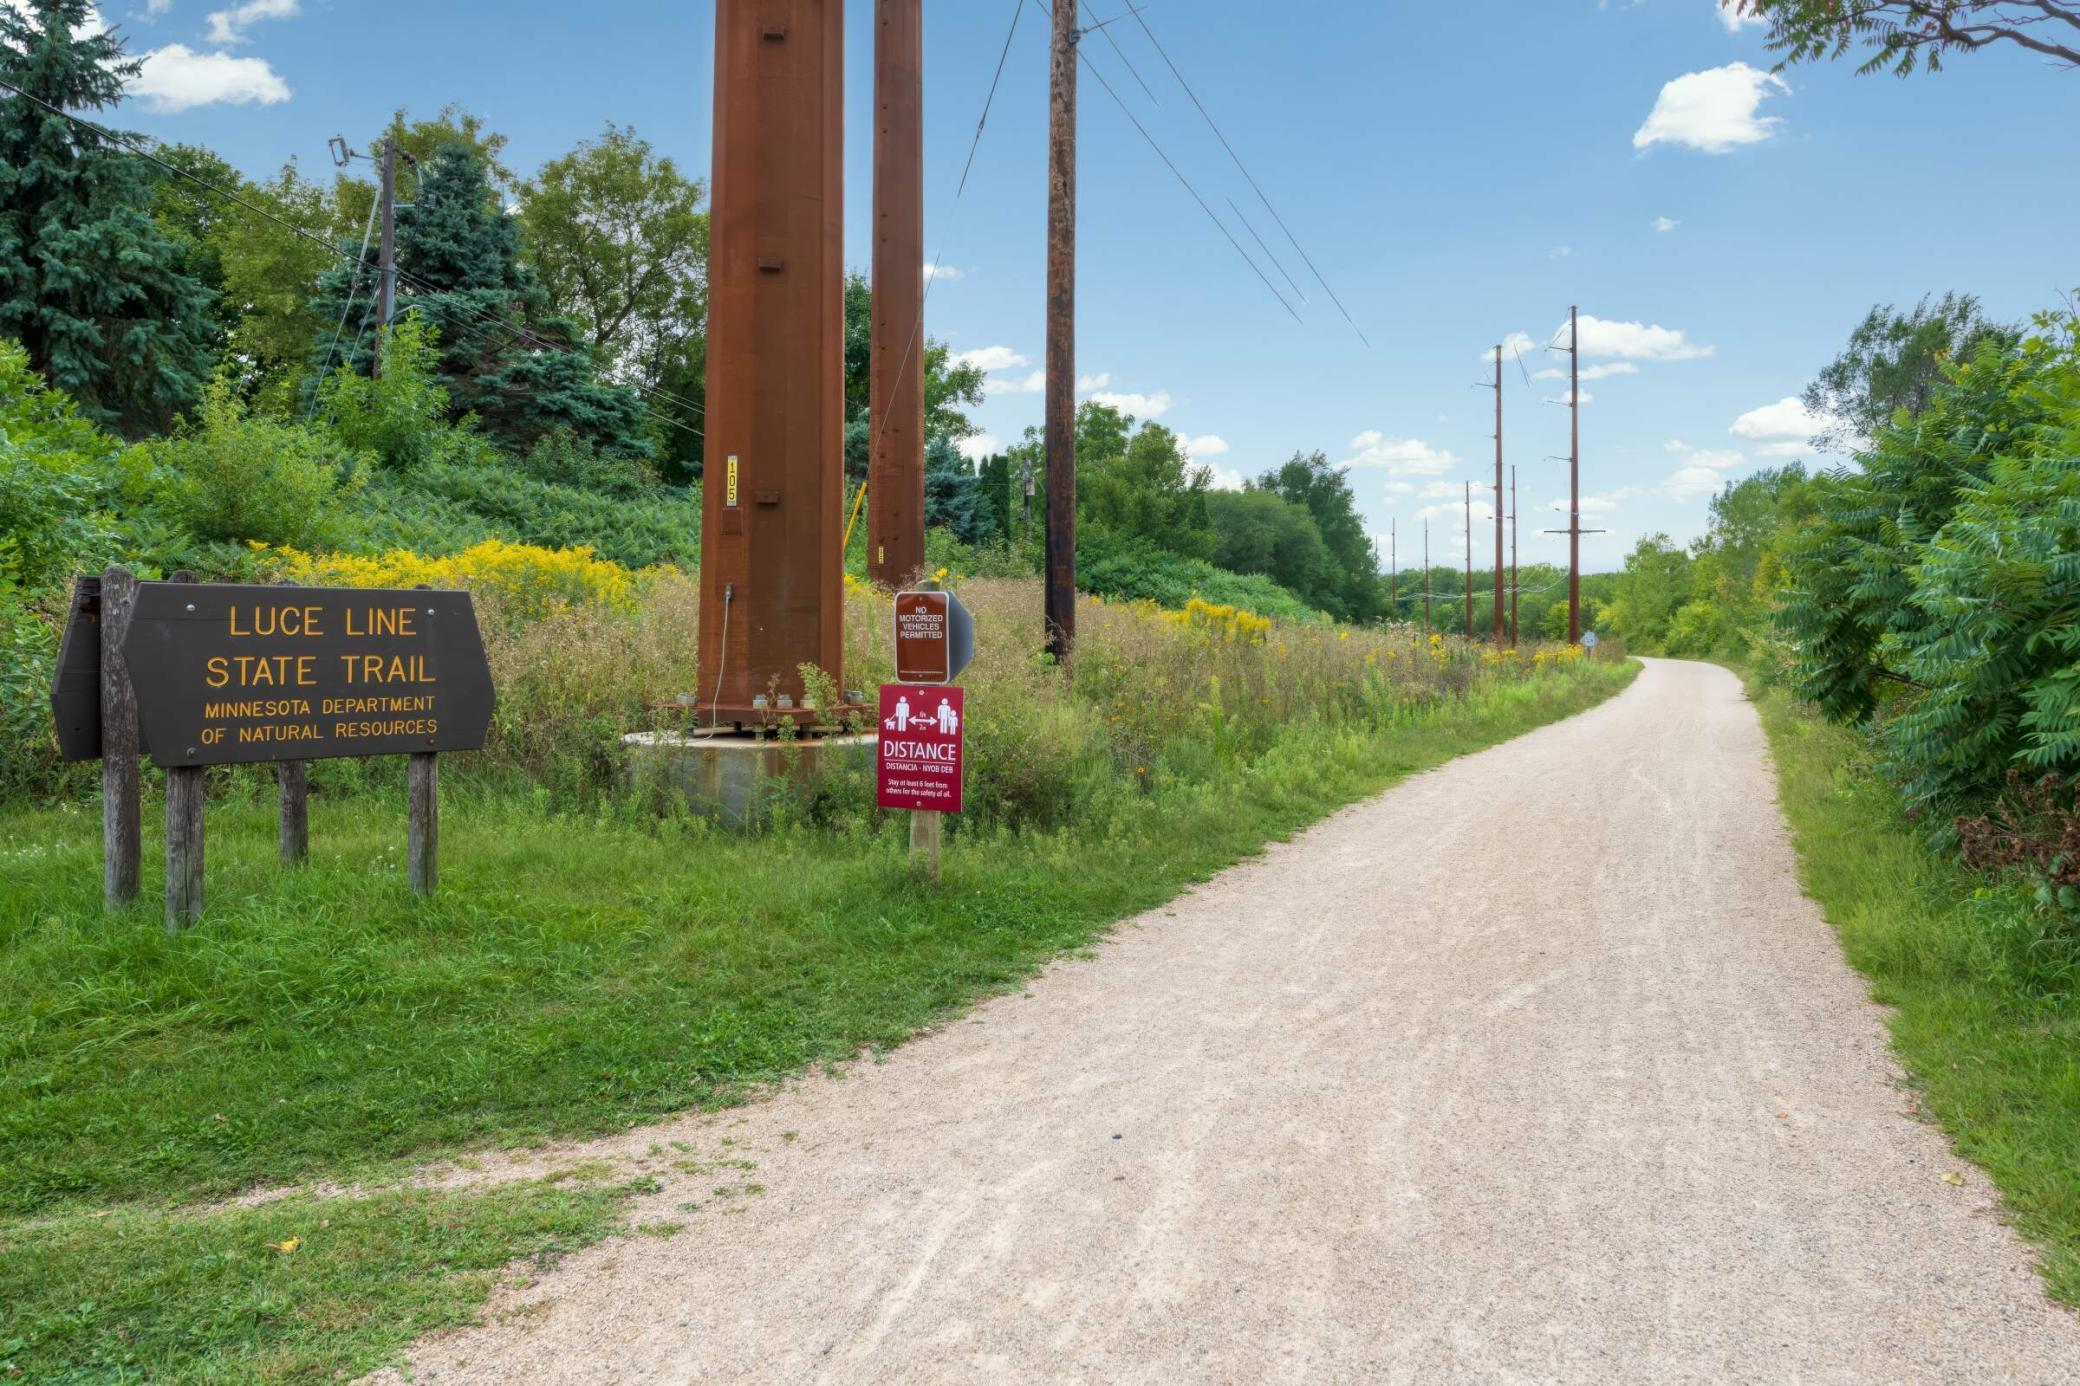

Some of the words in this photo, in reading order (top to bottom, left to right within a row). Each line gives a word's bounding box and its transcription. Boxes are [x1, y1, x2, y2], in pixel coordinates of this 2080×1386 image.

[230, 606, 324, 636] LUCE
[346, 607, 417, 636] LINE
[206, 655, 318, 688] STATE
[340, 655, 436, 684] TRAIL
[205, 700, 311, 719] MINNESOTA
[322, 696, 436, 715] DEPARTMENT
[201, 728, 227, 744] OF
[239, 725, 325, 743] NATURAL
[335, 719, 438, 738] RESOURCES
[884, 740, 956, 760] DISTANCE
[886, 762, 918, 771] DISTANCIA
[922, 764, 940, 772] NYOB
[940, 766, 954, 774] DEB
[888, 778, 898, 787] Stay
[920, 790, 936, 798] safety
